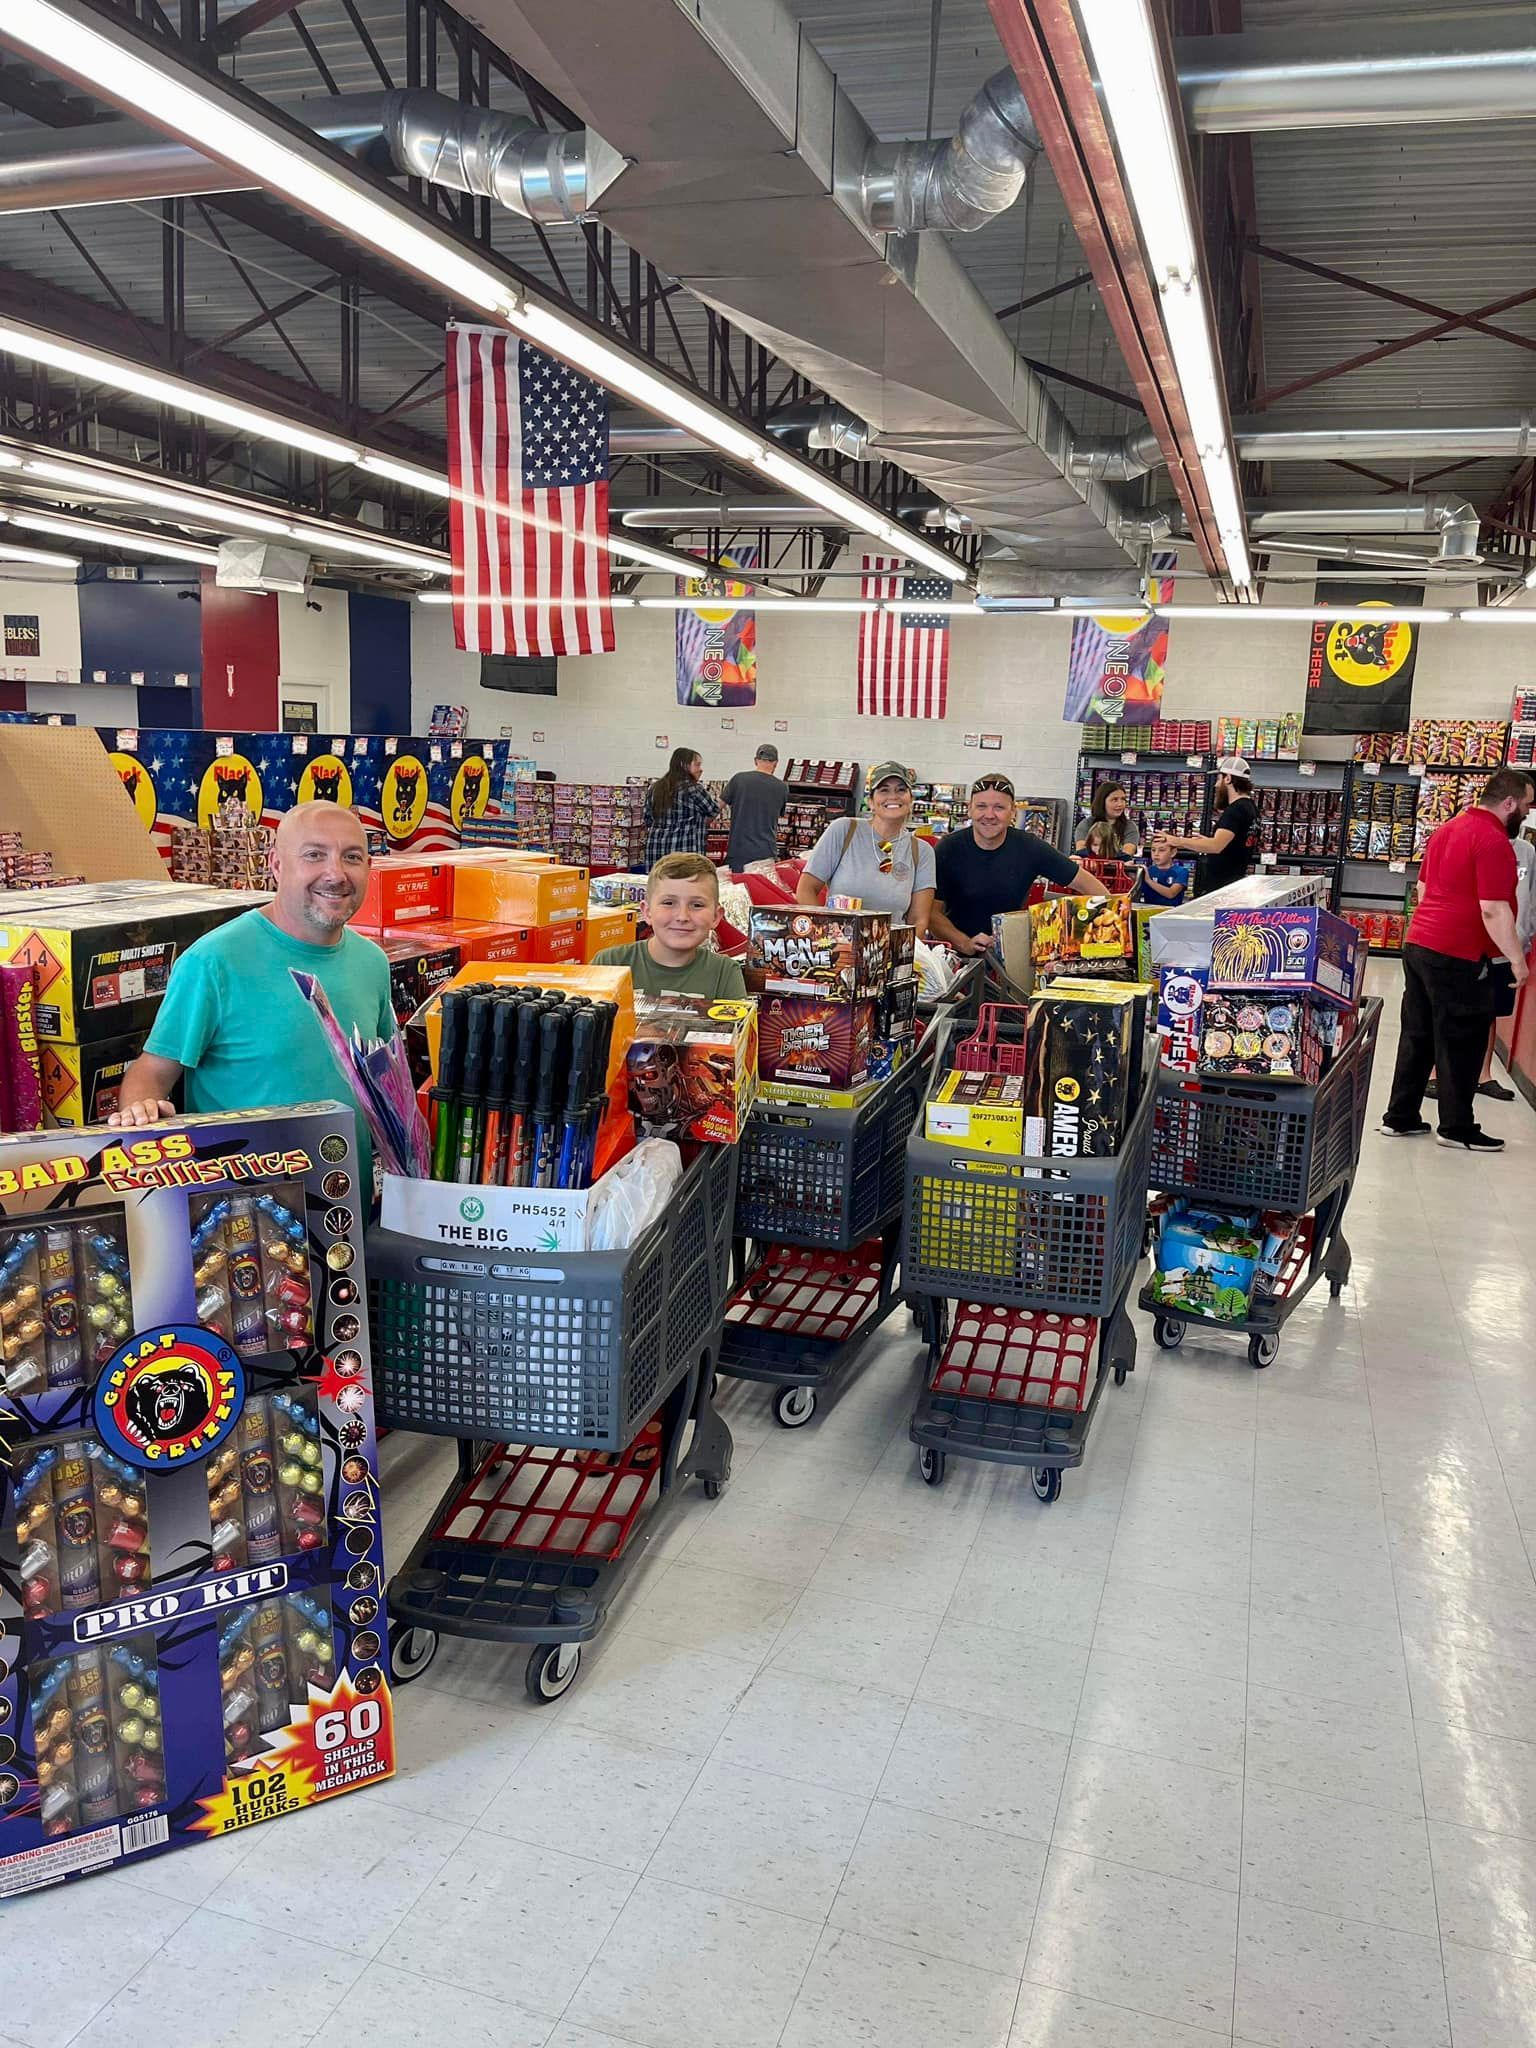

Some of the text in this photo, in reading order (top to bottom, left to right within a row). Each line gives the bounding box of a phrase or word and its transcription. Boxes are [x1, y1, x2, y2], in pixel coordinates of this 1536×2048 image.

[7, 627, 35, 640] BLESS
[1334, 622, 1354, 662] Cat
[703, 628, 726, 701] NEON
[1309, 647, 1324, 689] HERE
[1100, 639, 1130, 718] NEON
[392, 806, 412, 822] Cat
[397, 883, 411, 892] SKY
[629, 887, 645, 902] 36
[1270, 912, 1313, 929] Glitters
[97, 951, 120, 966] THREE
[120, 947, 140, 962] MULTI
[488, 950, 500, 960] SKY
[763, 937, 813, 962] MAN
[425, 966, 453, 979] TARGET
[786, 950, 832, 977] CAVE
[16, 981, 38, 1052] Blaster
[780, 1023, 825, 1042] TIGER
[779, 1035, 830, 1057] PRIDE
[100, 1064, 124, 1079] THREE
[1051, 1102, 1081, 1157] AMER
[1082, 1117, 1099, 1154] Proud
[0, 1134, 194, 1196] BAD ASS
[512, 1203, 566, 1218] PH5452
[437, 1224, 509, 1242] THE BIG
[548, 1219, 566, 1229] 4/1
[473, 1264, 484, 1272] KG
[519, 1267, 530, 1275] KG
[103, 1333, 176, 1407] GREAT
[145, 1371, 236, 1460] GRIZZLY
[84, 1568, 280, 1637] PRO KIT
[314, 1700, 381, 1750] 60
[323, 1739, 375, 1764] SHELLS
[325, 1751, 375, 1777] IN THIS
[232, 1772, 286, 1805] 102
[315, 1760, 386, 1793] MEGAPACK
[223, 1797, 300, 1830] BREAKS
[235, 1791, 288, 1816] HUGE
[94, 1827, 113, 1839] BALLS
